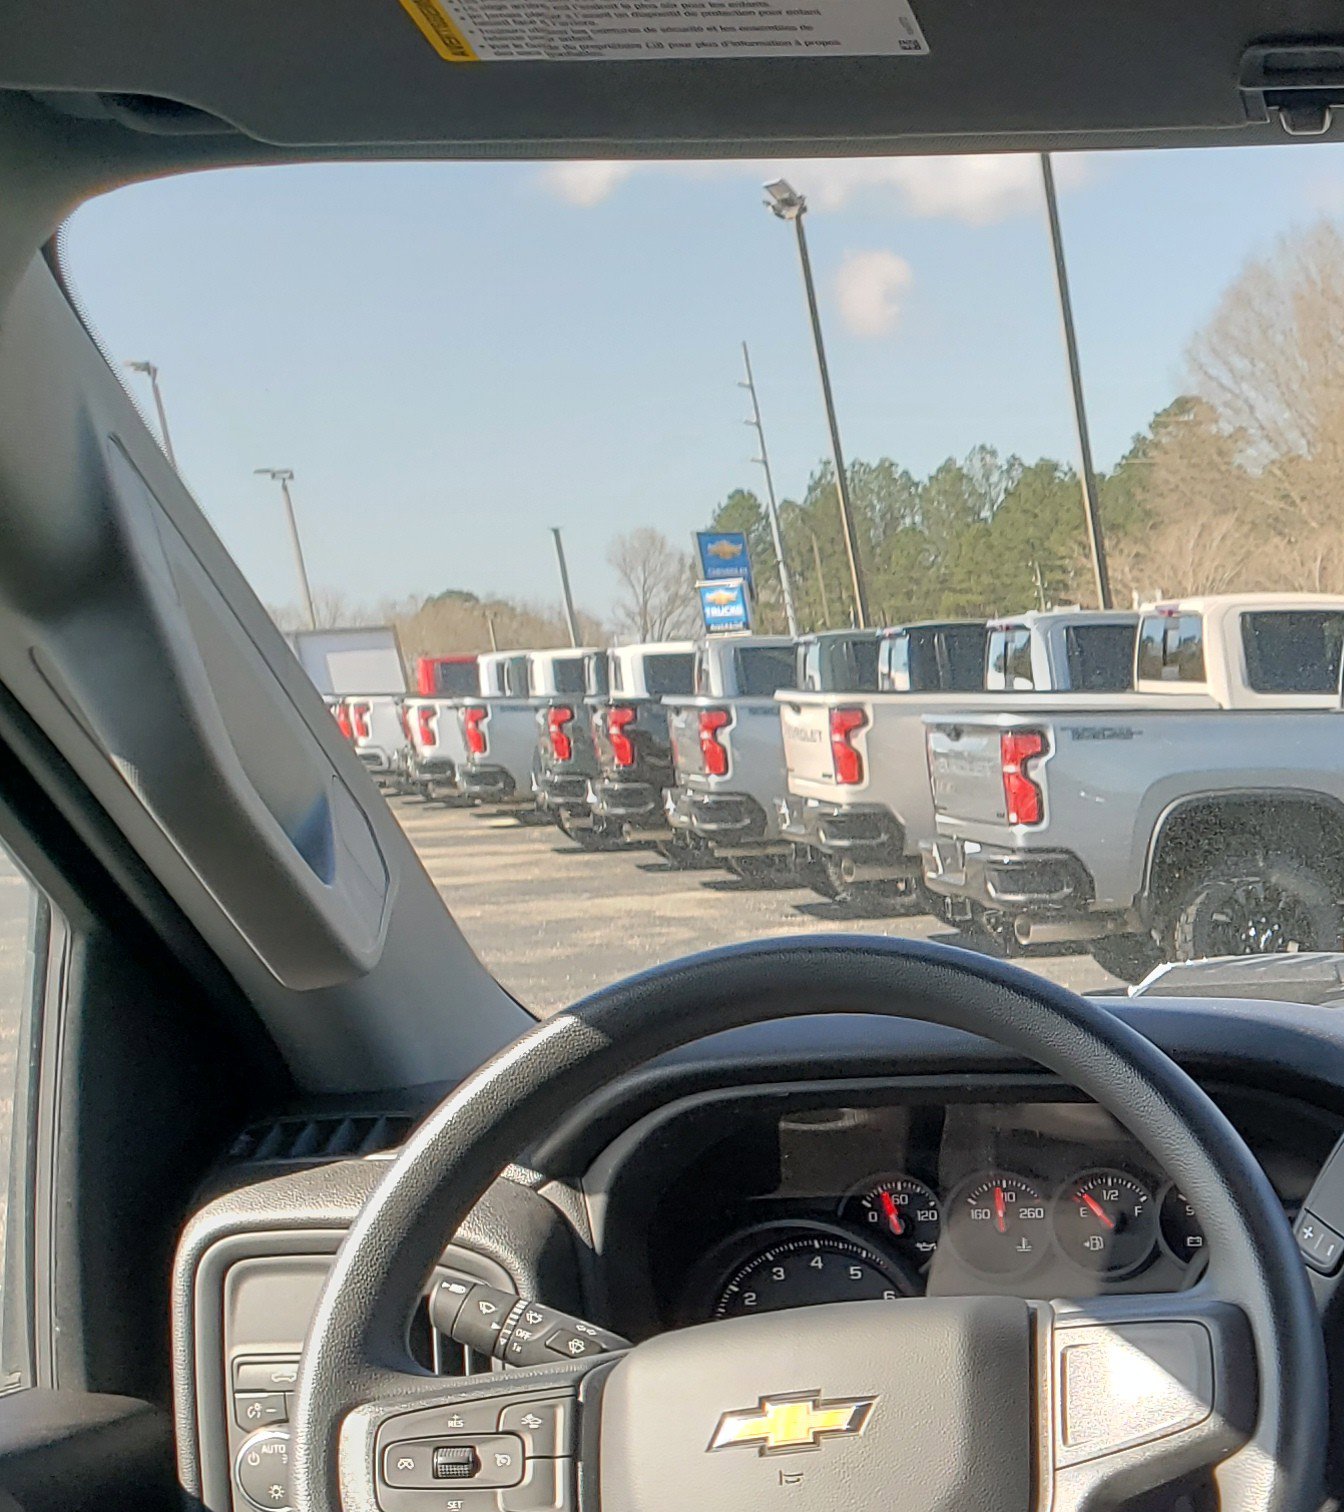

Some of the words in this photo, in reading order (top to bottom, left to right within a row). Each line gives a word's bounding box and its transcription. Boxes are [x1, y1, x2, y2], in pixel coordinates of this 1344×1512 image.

[891, 1193, 909, 1206] 60
[1101, 1189, 1119, 1202] 1/2
[868, 1211, 878, 1223] 0
[916, 1209, 938, 1222] 120
[970, 1208, 991, 1220] 160
[1019, 1207, 1044, 1219] 260
[1079, 1206, 1089, 1218] E
[1134, 1206, 1144, 1218] F
[810, 1255, 824, 1269] 4
[772, 1267, 786, 1281] 3
[849, 1266, 863, 1280] 5
[743, 1292, 758, 1306] 2
[883, 1290, 896, 1300] 6
[515, 1328, 533, 1341] OFF
[447, 1419, 465, 1429] RES
[260, 1444, 287, 1455] AUTO
[447, 1500, 464, 1510] SET
